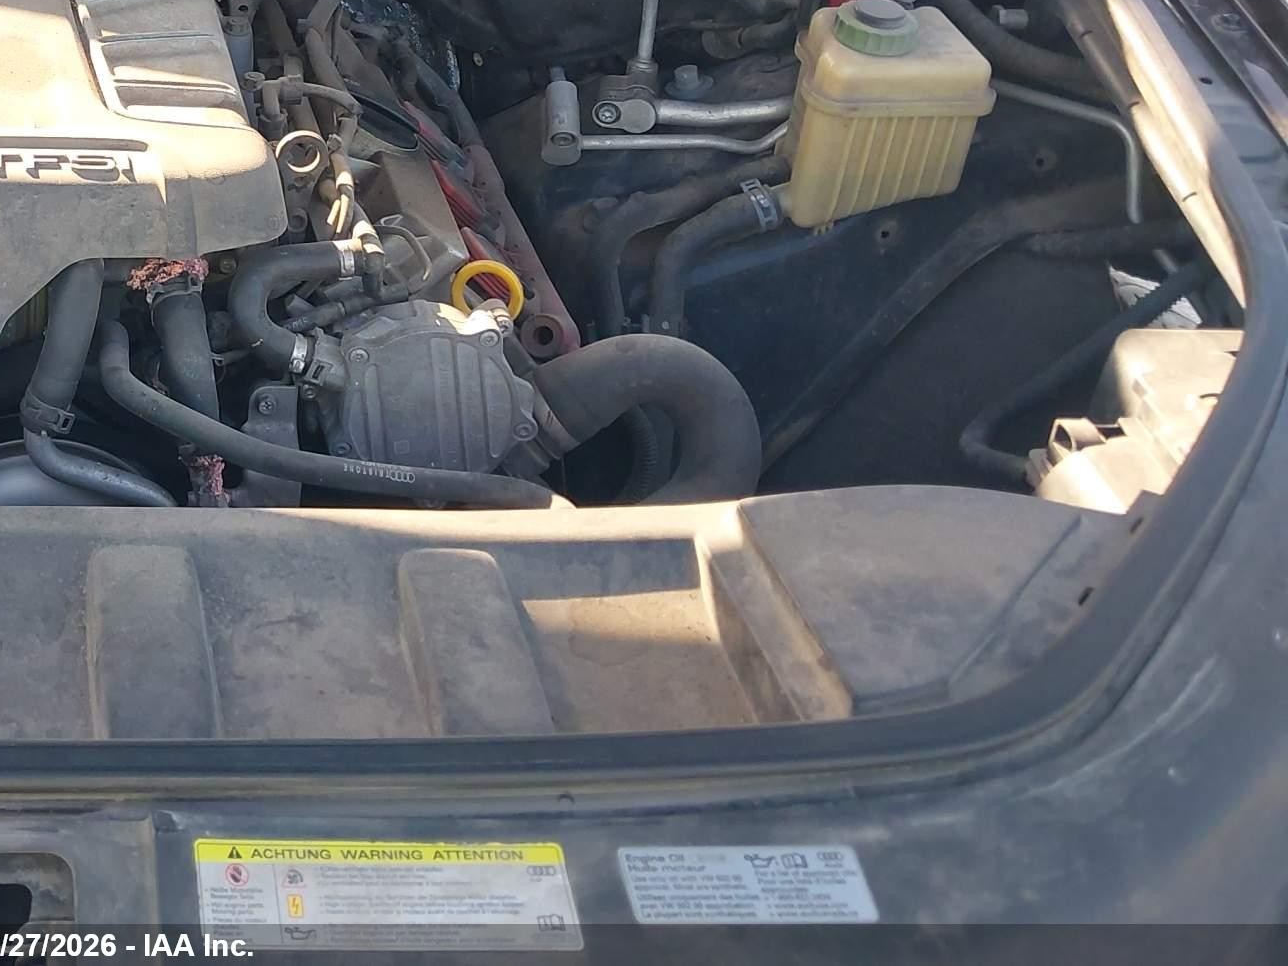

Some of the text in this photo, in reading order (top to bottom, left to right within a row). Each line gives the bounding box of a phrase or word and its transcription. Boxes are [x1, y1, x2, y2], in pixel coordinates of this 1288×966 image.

[250, 848, 524, 861] ACHTUNG WARNING ATTENTION
[625, 853, 665, 864] Engine
[668, 853, 685, 863] Oil
